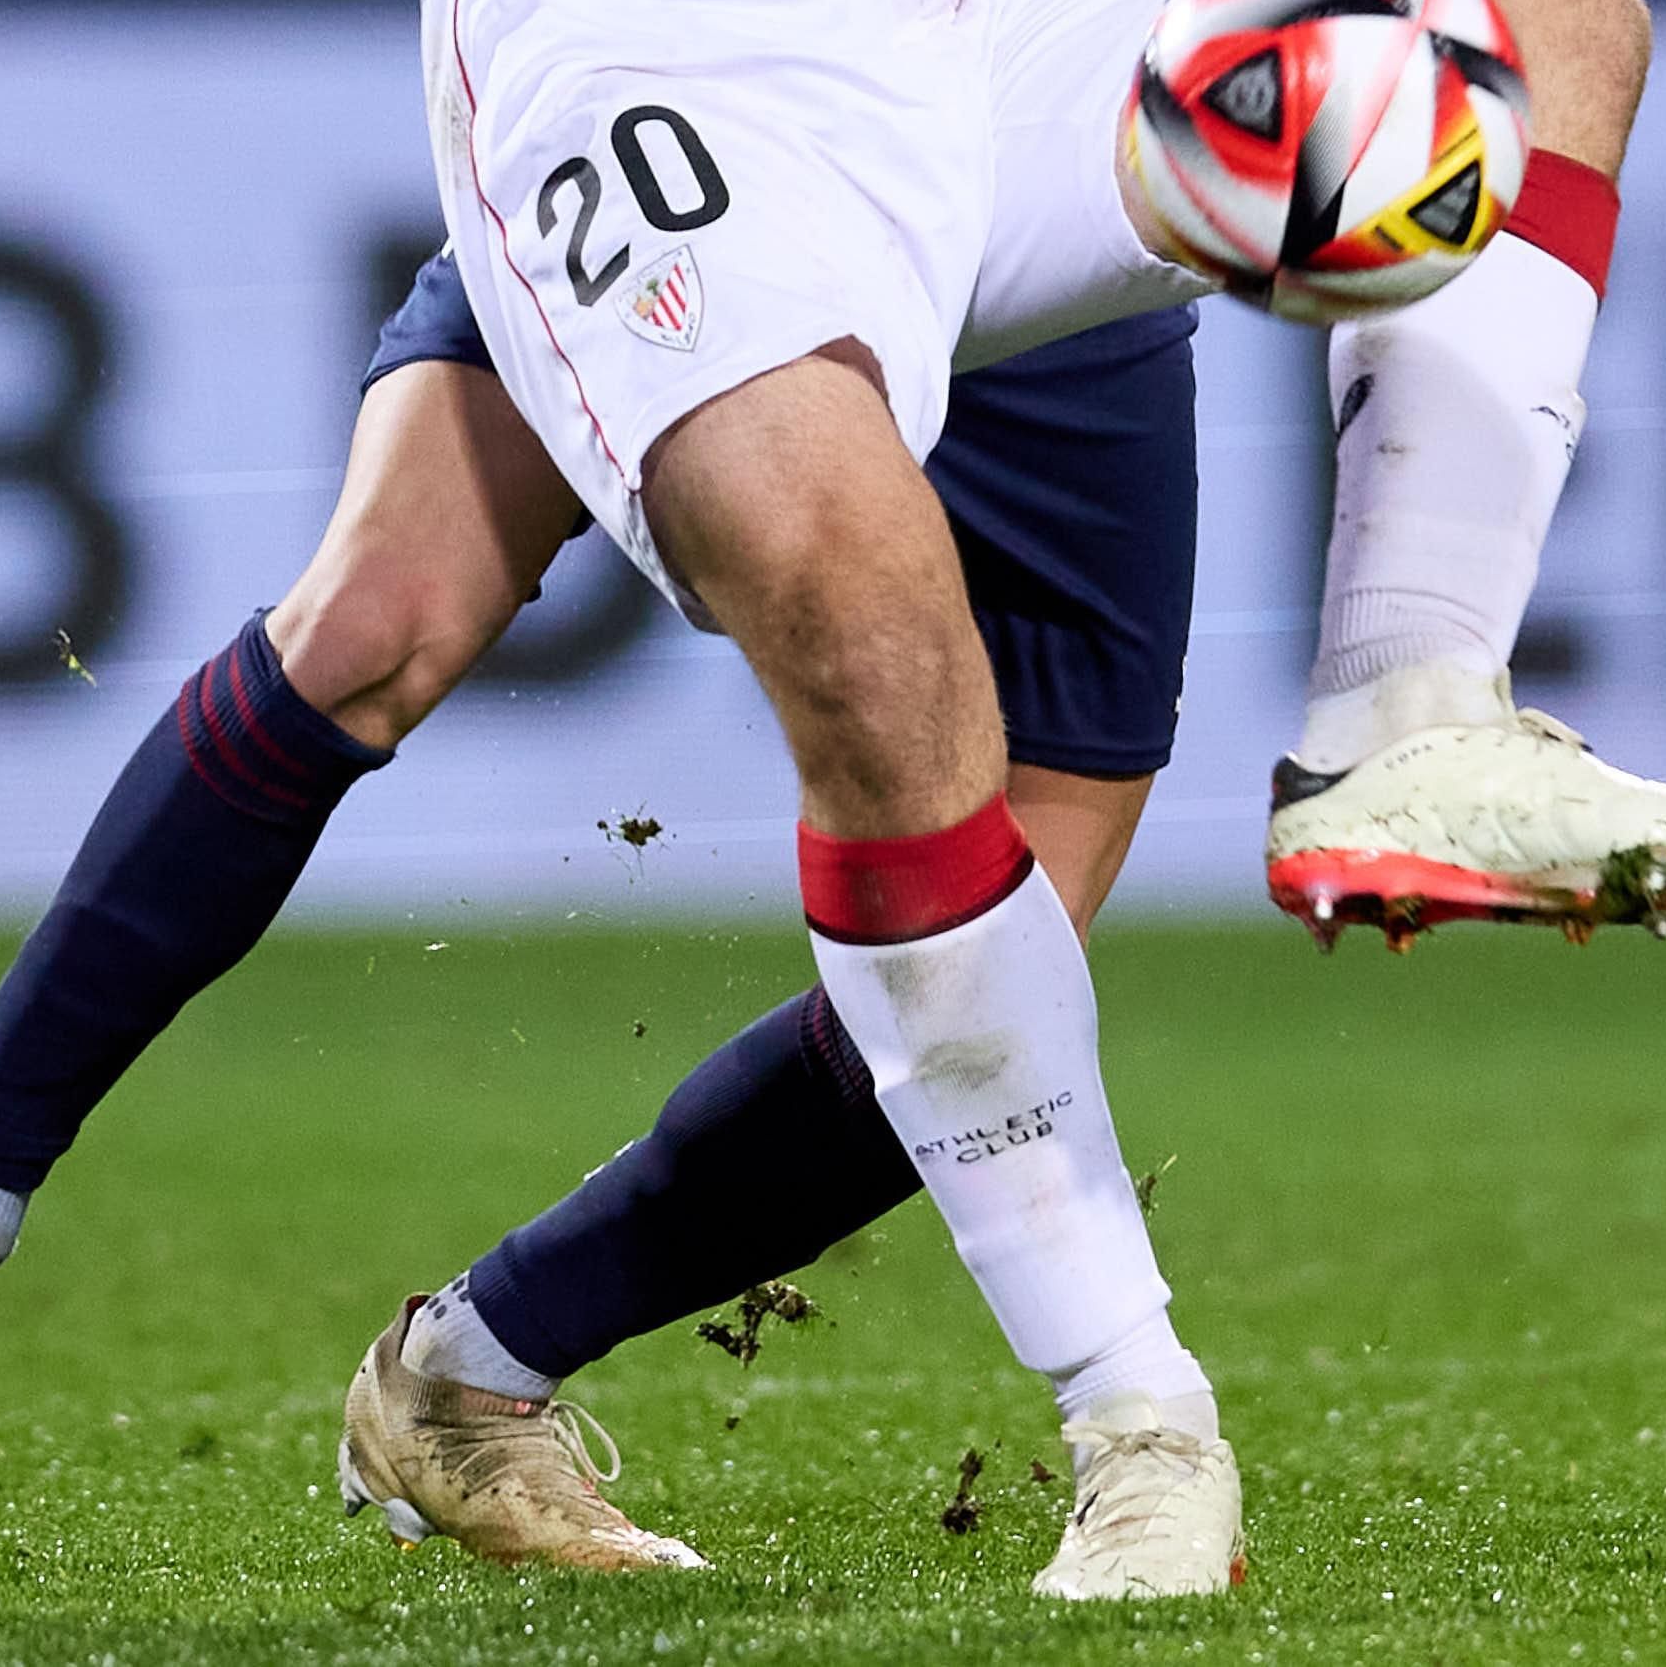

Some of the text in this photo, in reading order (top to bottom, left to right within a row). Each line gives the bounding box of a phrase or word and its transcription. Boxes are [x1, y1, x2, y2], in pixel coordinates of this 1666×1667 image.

[537, 105, 730, 307] 20
[915, 1091, 1073, 1157] ATHLETIC
[956, 1121, 1053, 1164] CLUB
